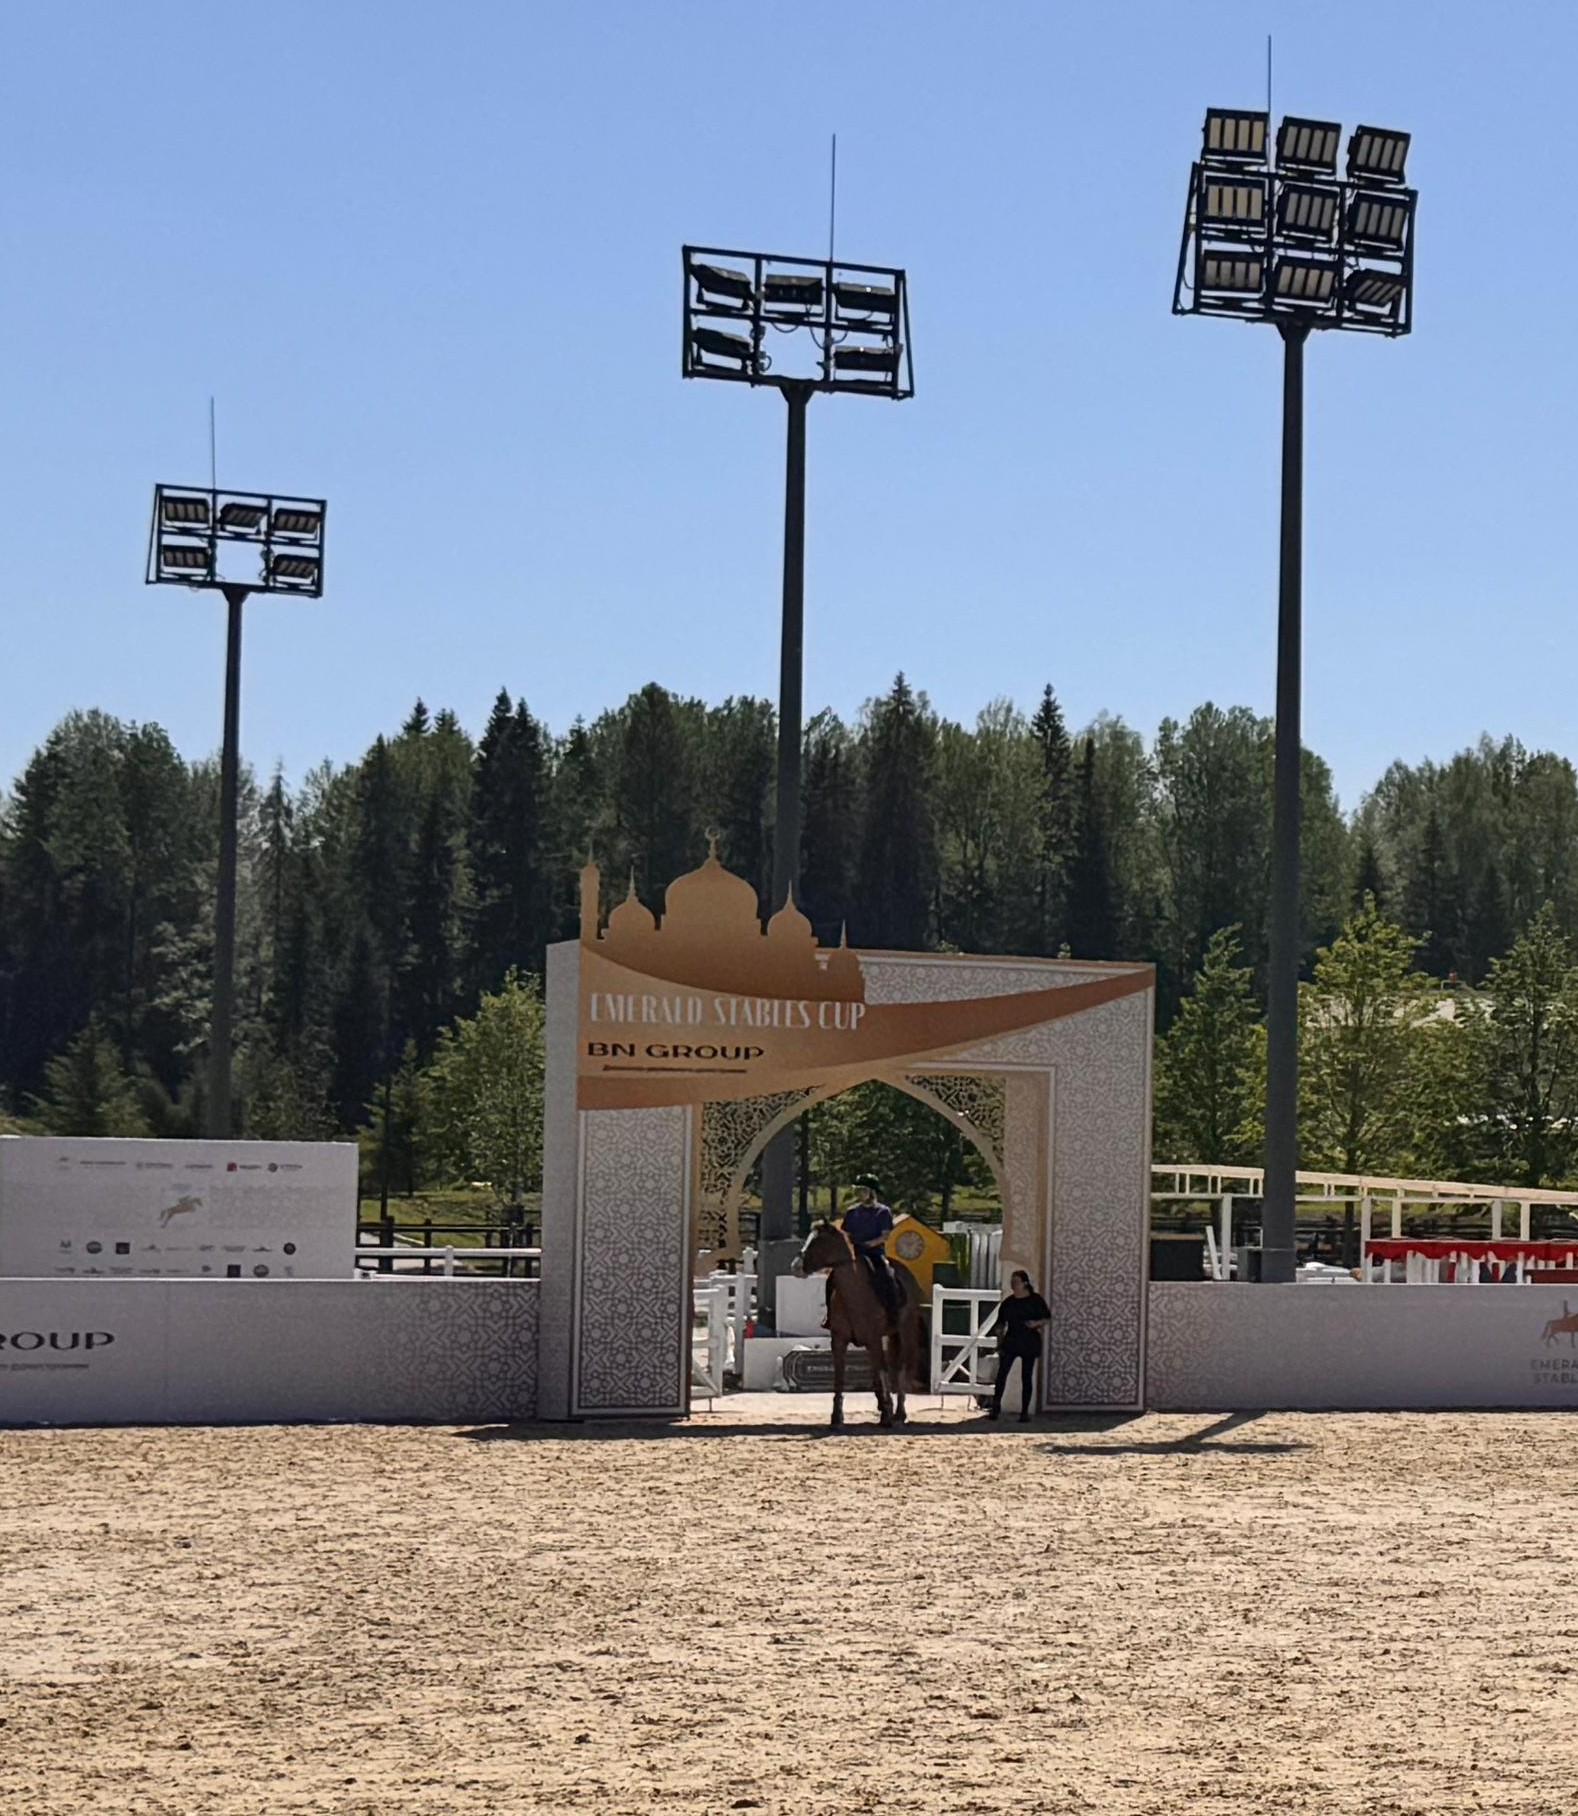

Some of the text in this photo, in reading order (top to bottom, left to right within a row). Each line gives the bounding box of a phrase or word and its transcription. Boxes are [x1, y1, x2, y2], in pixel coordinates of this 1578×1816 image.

[591, 993, 866, 1031] EMERALD STABLES CUP
[588, 1042, 765, 1061] BN GROUP
[0, 1331, 115, 1350] OUP
